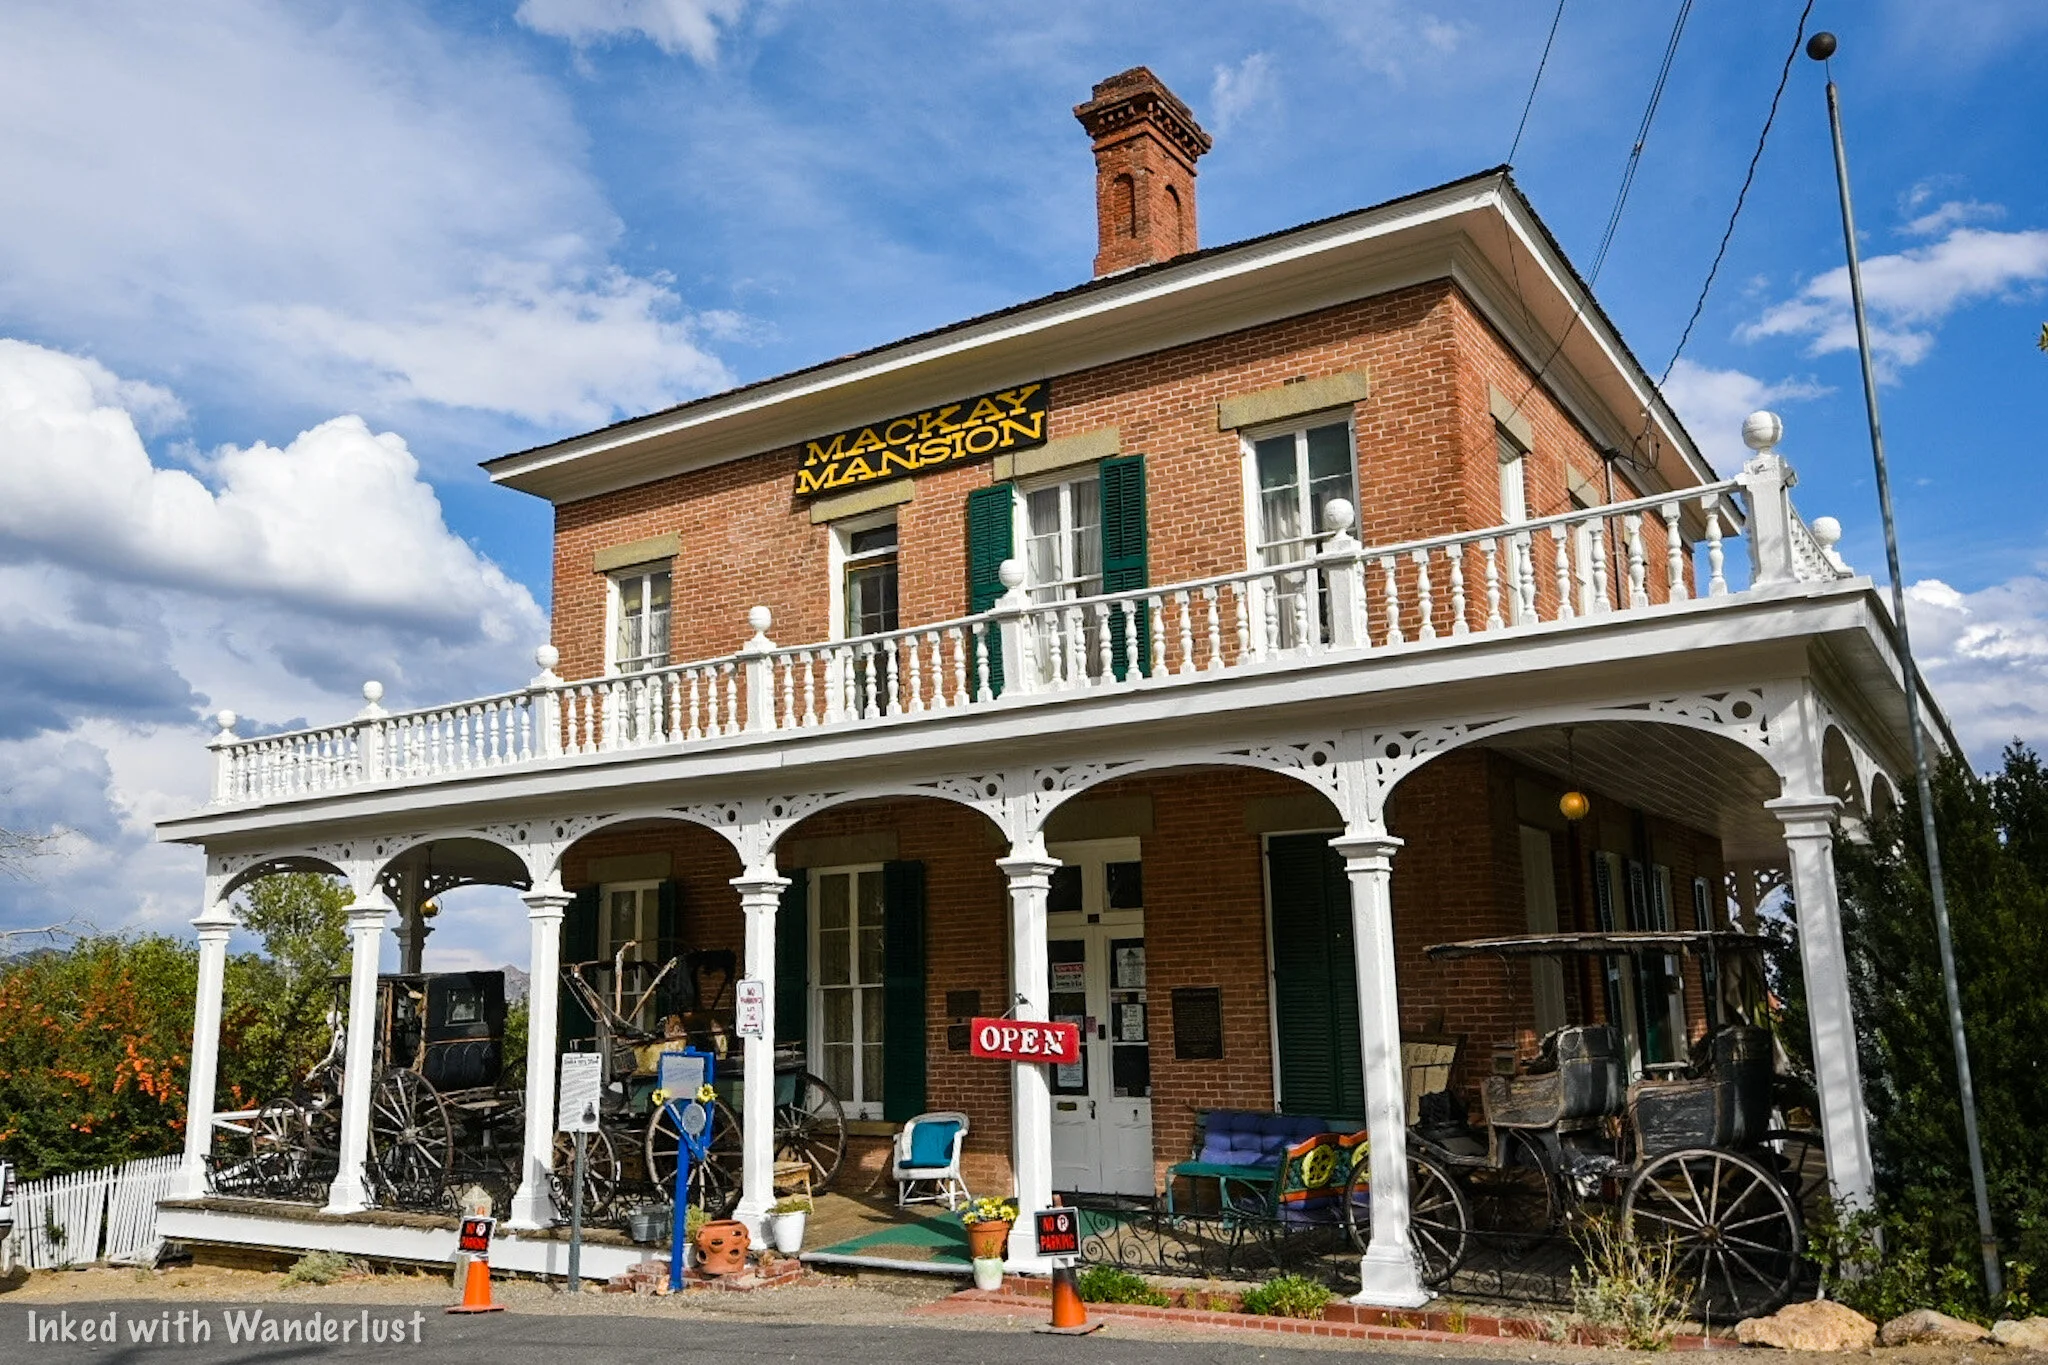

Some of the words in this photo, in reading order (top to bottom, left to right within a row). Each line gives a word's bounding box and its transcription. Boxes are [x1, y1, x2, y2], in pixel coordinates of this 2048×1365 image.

[804, 384, 1041, 466] MACKAY
[796, 410, 1045, 494] MANSION
[980, 1026, 1065, 1055] OPEN
[1042, 1216, 1055, 1232] NO
[1040, 1233, 1075, 1250] PARKING
